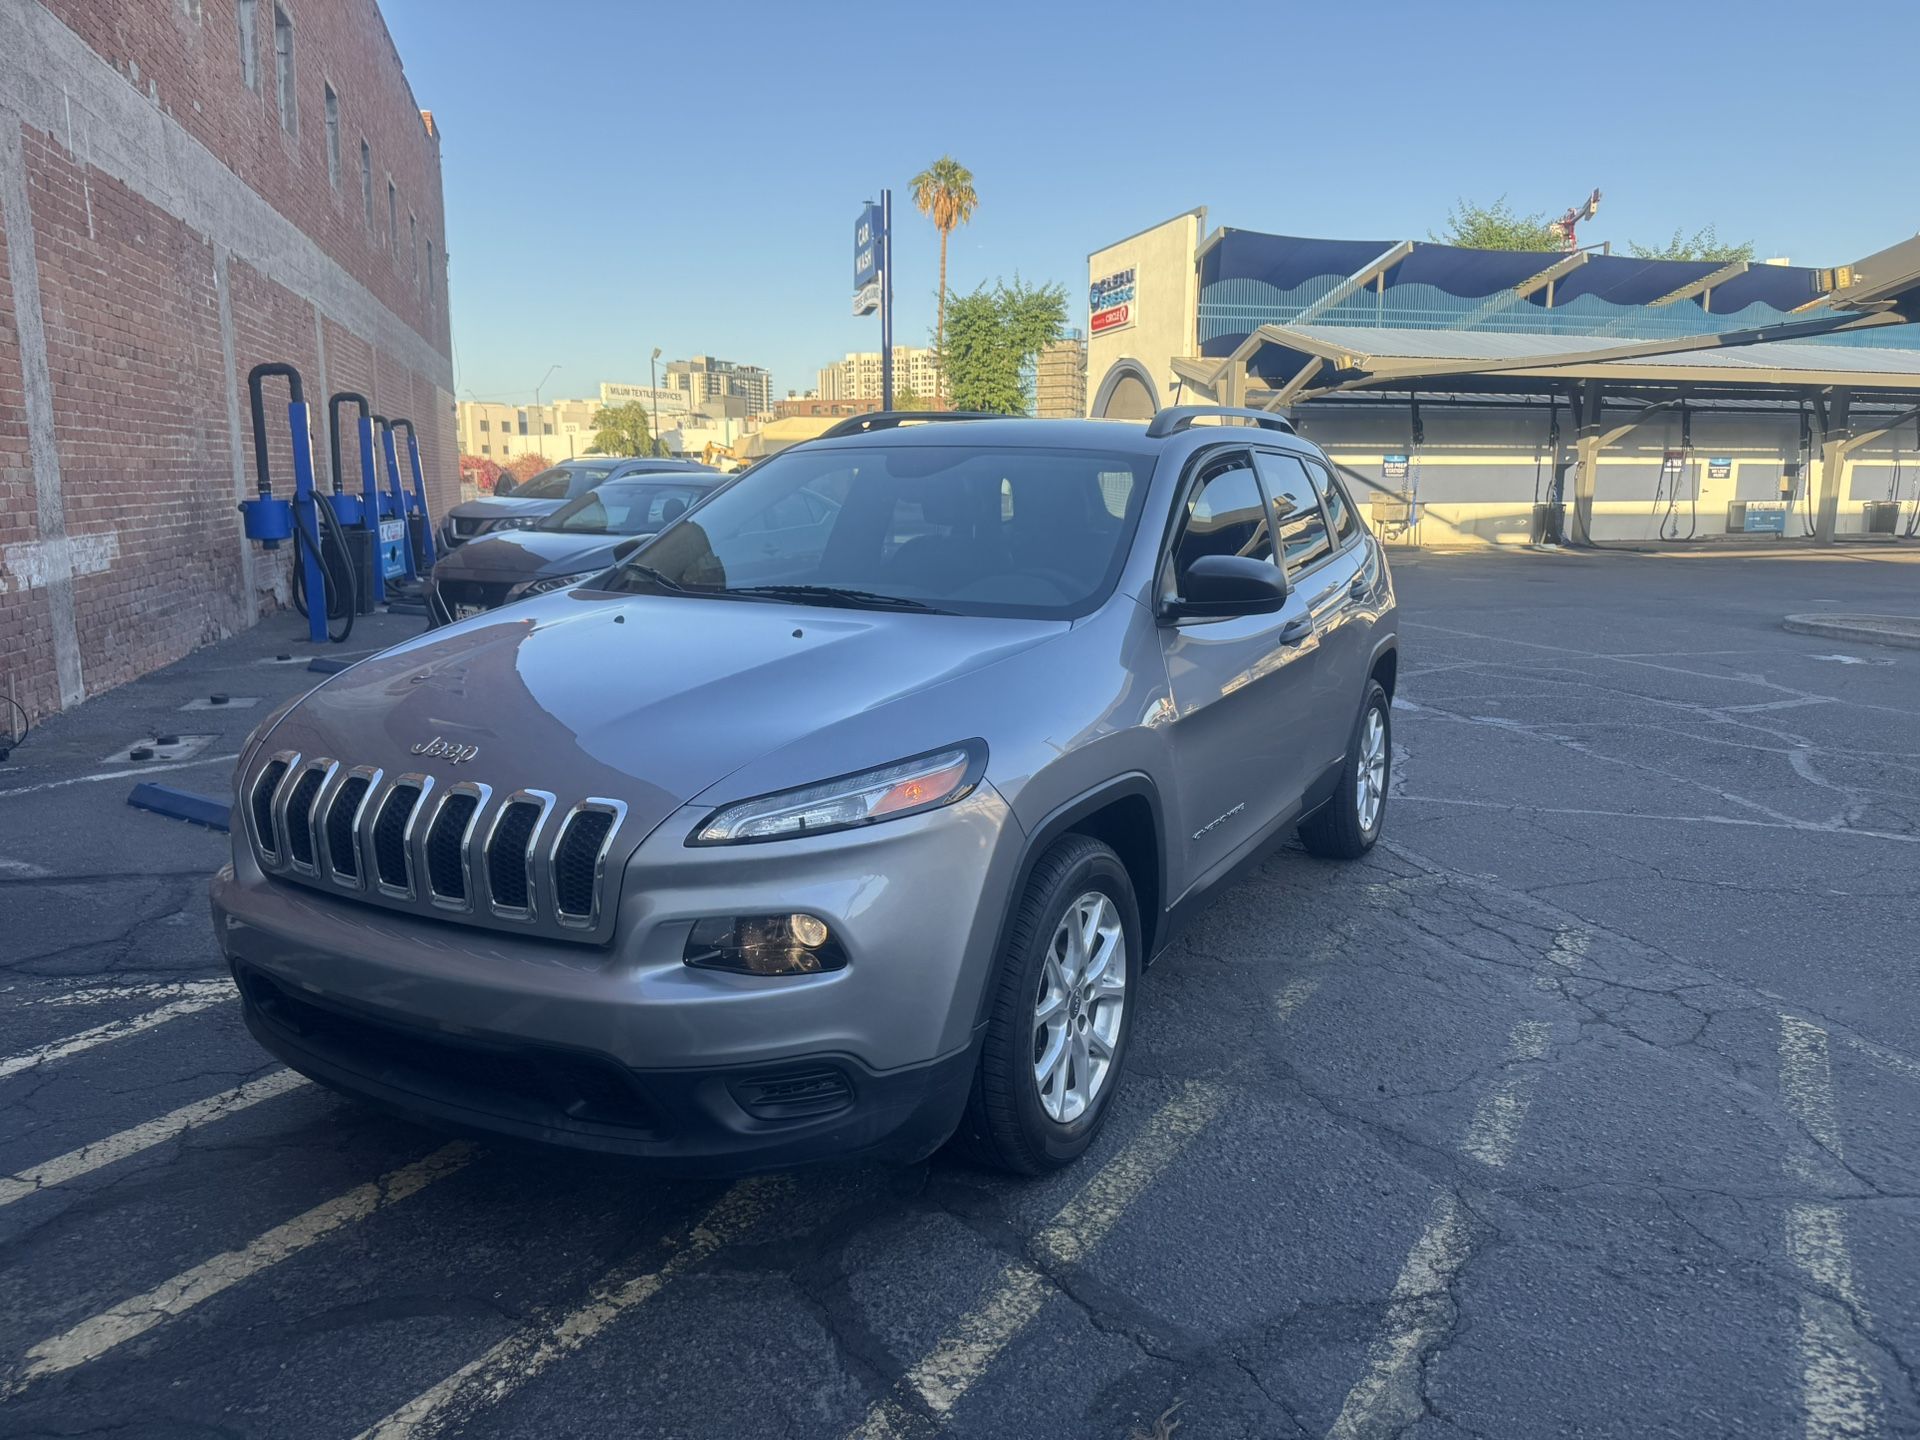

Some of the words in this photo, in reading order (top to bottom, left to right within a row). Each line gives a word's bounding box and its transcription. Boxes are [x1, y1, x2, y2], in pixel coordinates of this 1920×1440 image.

[858, 223, 868, 247] CAR
[856, 248, 872, 274] WASH
[1105, 309, 1120, 323] CIRCLE
[610, 387, 630, 396] MILUM
[632, 389, 654, 399] TEXTILE
[655, 391, 683, 401] SERVICES
[410, 736, 478, 765] Jeep
